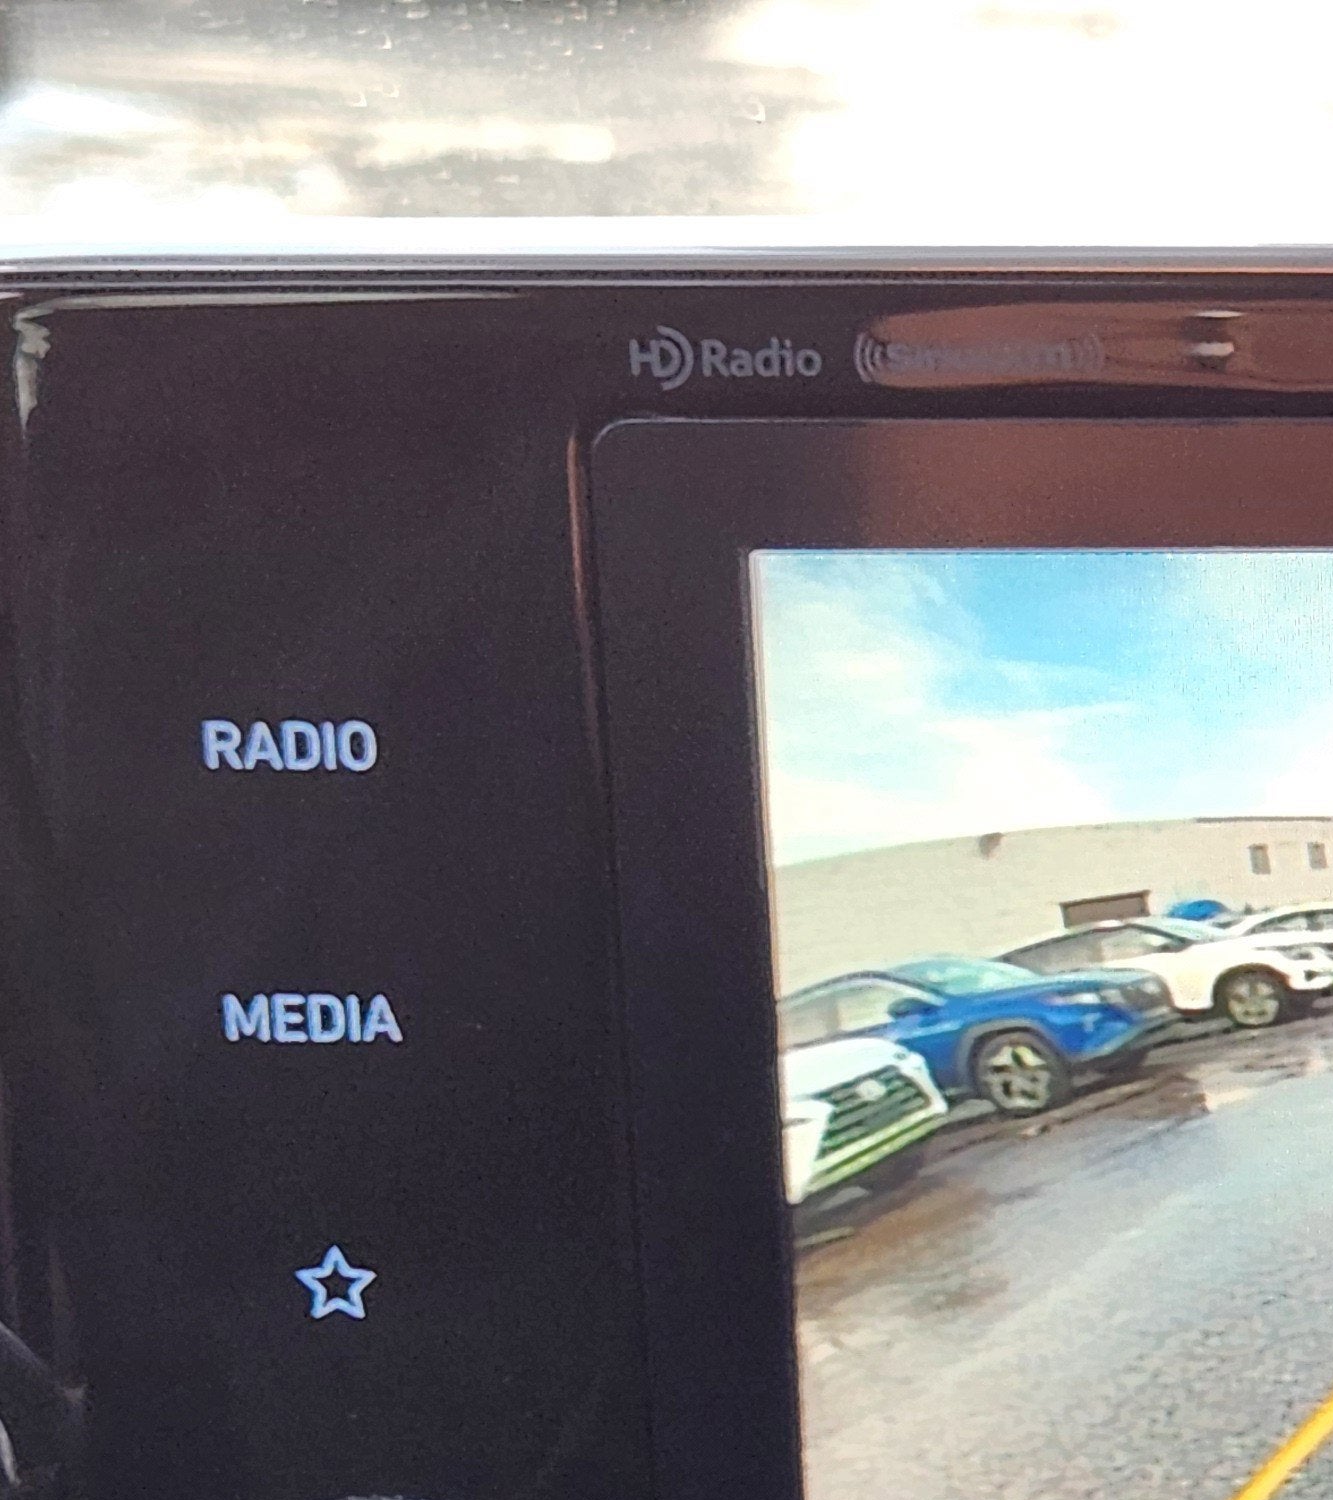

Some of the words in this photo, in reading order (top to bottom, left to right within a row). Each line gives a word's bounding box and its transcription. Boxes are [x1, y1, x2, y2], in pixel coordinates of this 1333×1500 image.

[628, 325, 694, 391] HD
[701, 337, 822, 377] Radio
[203, 720, 378, 772] RADIO
[222, 993, 403, 1043] MEDIA
